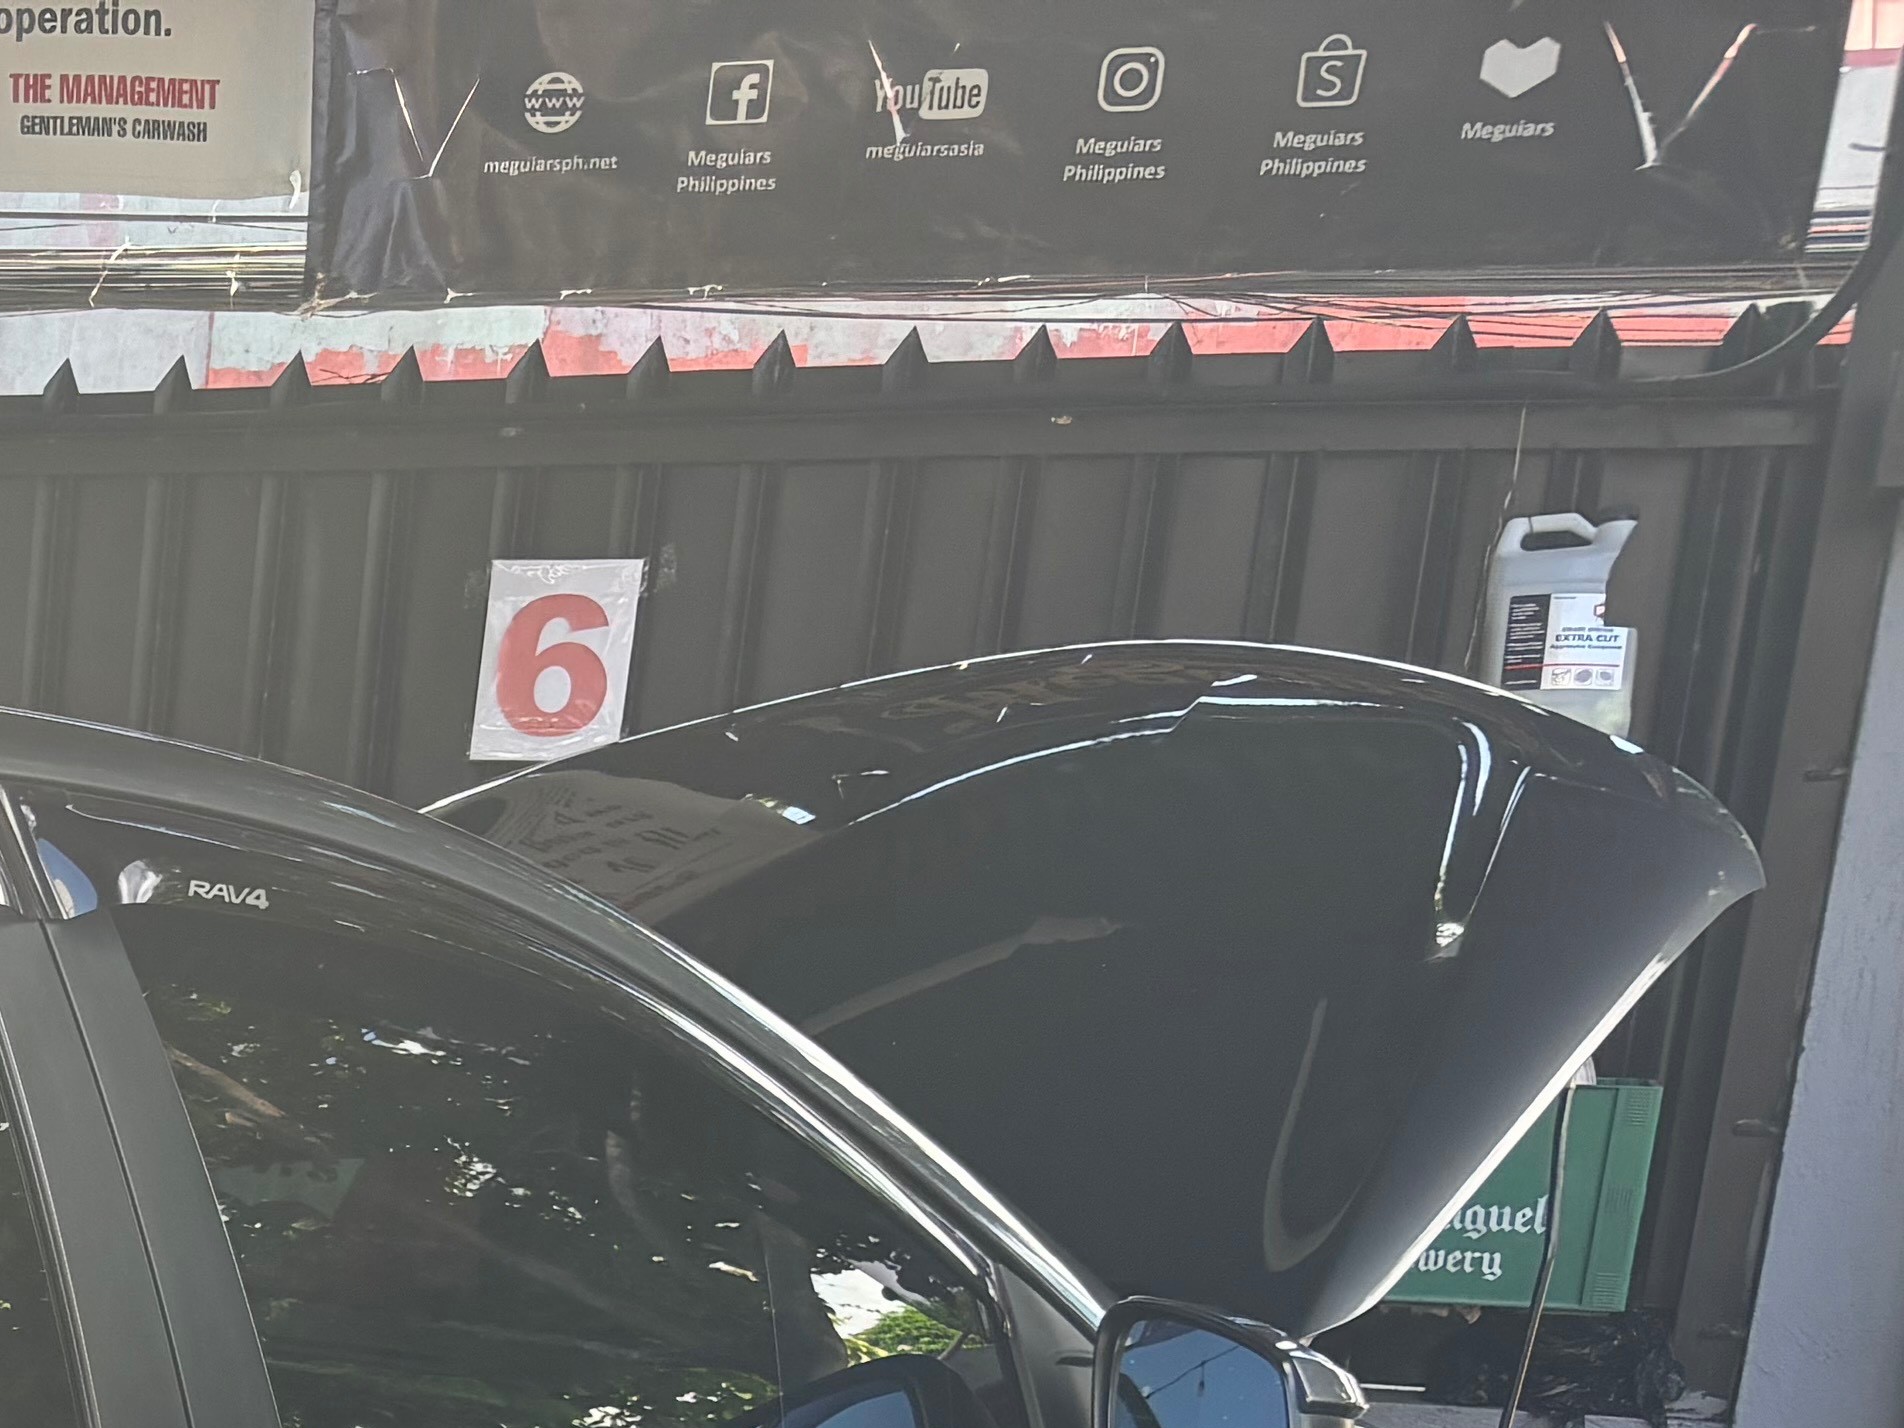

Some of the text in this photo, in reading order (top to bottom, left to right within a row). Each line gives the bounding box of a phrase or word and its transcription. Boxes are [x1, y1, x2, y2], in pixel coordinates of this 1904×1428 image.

[9, 73, 220, 110] THE MANAGEMENT
[874, 72, 983, 114] YouTube
[20, 115, 208, 142] GENTLEMAN'S CARWASH
[1460, 119, 1556, 143] Meguiars
[865, 140, 985, 161] meguiarsasia
[1075, 136, 1162, 158] Meguiars
[1273, 130, 1365, 151] Meguiars
[483, 155, 618, 177] meguiarsph.net
[687, 149, 772, 170] Meguiars
[1259, 156, 1367, 178] Philippines
[1062, 162, 1166, 185] Philippines
[677, 175, 777, 196] Philippines
[1596, 634, 1620, 643] CUT
[496, 593, 609, 737] 6
[188, 880, 269, 910] RAV4
[1444, 1194, 1549, 1239] iguel
[1410, 1249, 1503, 1281] wery
